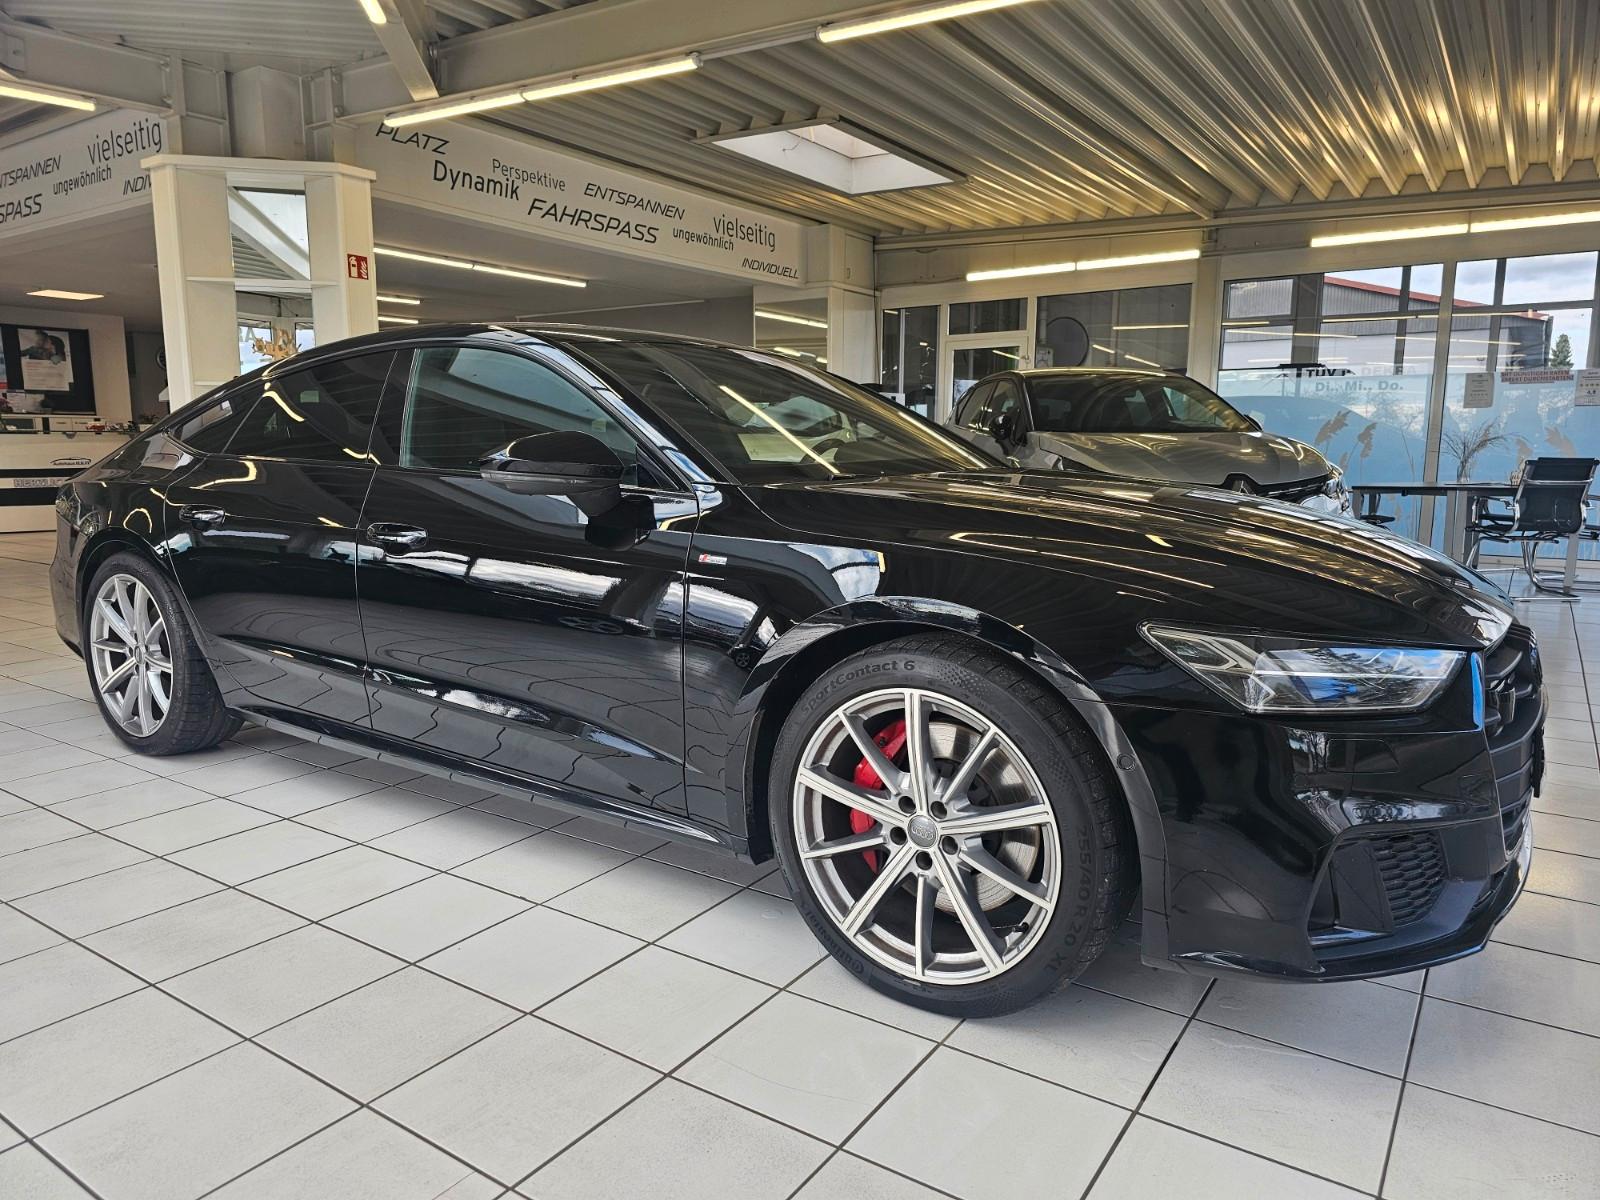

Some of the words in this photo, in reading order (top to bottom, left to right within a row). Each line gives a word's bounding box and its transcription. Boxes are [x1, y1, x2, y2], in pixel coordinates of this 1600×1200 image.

[88, 118, 161, 165] vielseitig
[375, 123, 450, 155] PLATZ
[0, 154, 61, 188] TSPANNEN
[53, 164, 112, 195] ungewöhnlich
[433, 160, 519, 200] Dynamik
[492, 158, 566, 192] Perspektive
[584, 182, 685, 220] ENTSPANNEN
[527, 198, 660, 244] FAHRSPASS
[713, 214, 776, 252] vielseitig
[673, 227, 734, 251] ungewöhnlich
[742, 257, 799, 279] INDIVIDUELL
[903, 660, 916, 671] 6
